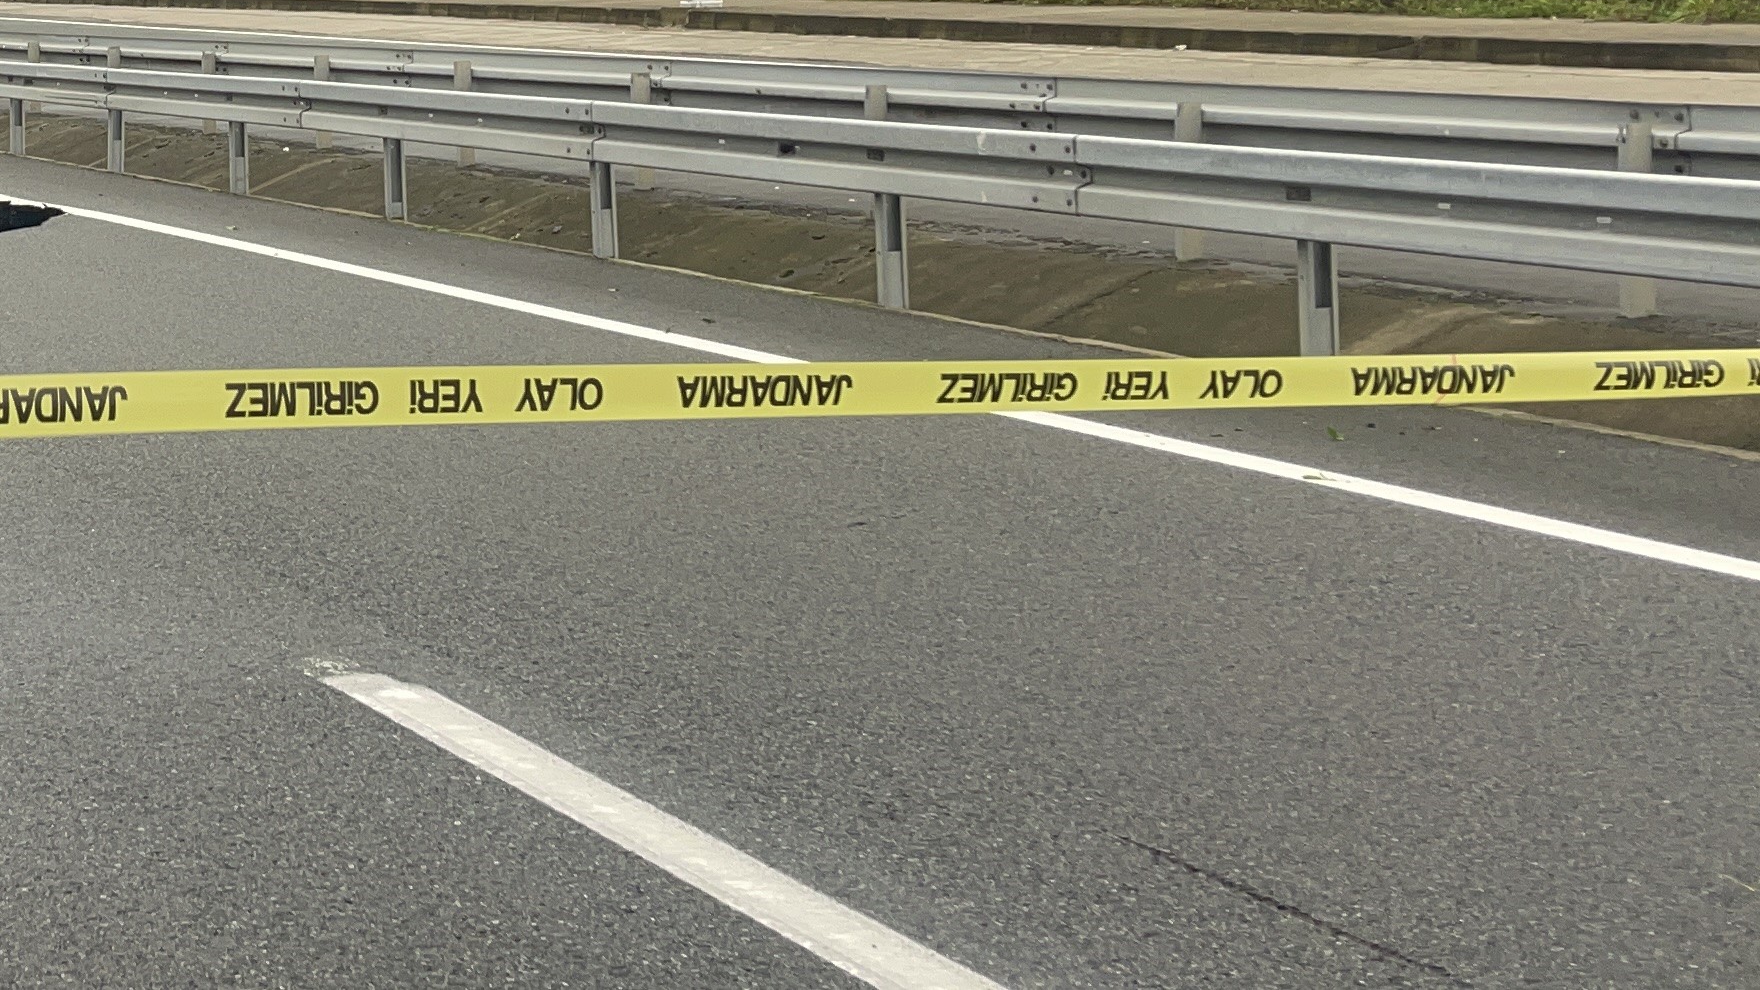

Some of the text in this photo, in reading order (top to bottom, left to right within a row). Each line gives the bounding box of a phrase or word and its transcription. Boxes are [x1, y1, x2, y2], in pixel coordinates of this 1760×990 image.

[515, 378, 605, 414] OLAY
[677, 375, 854, 410] JANDARMA
[1199, 370, 1285, 401] OLAY
[1351, 365, 1517, 398] JANDARMA
